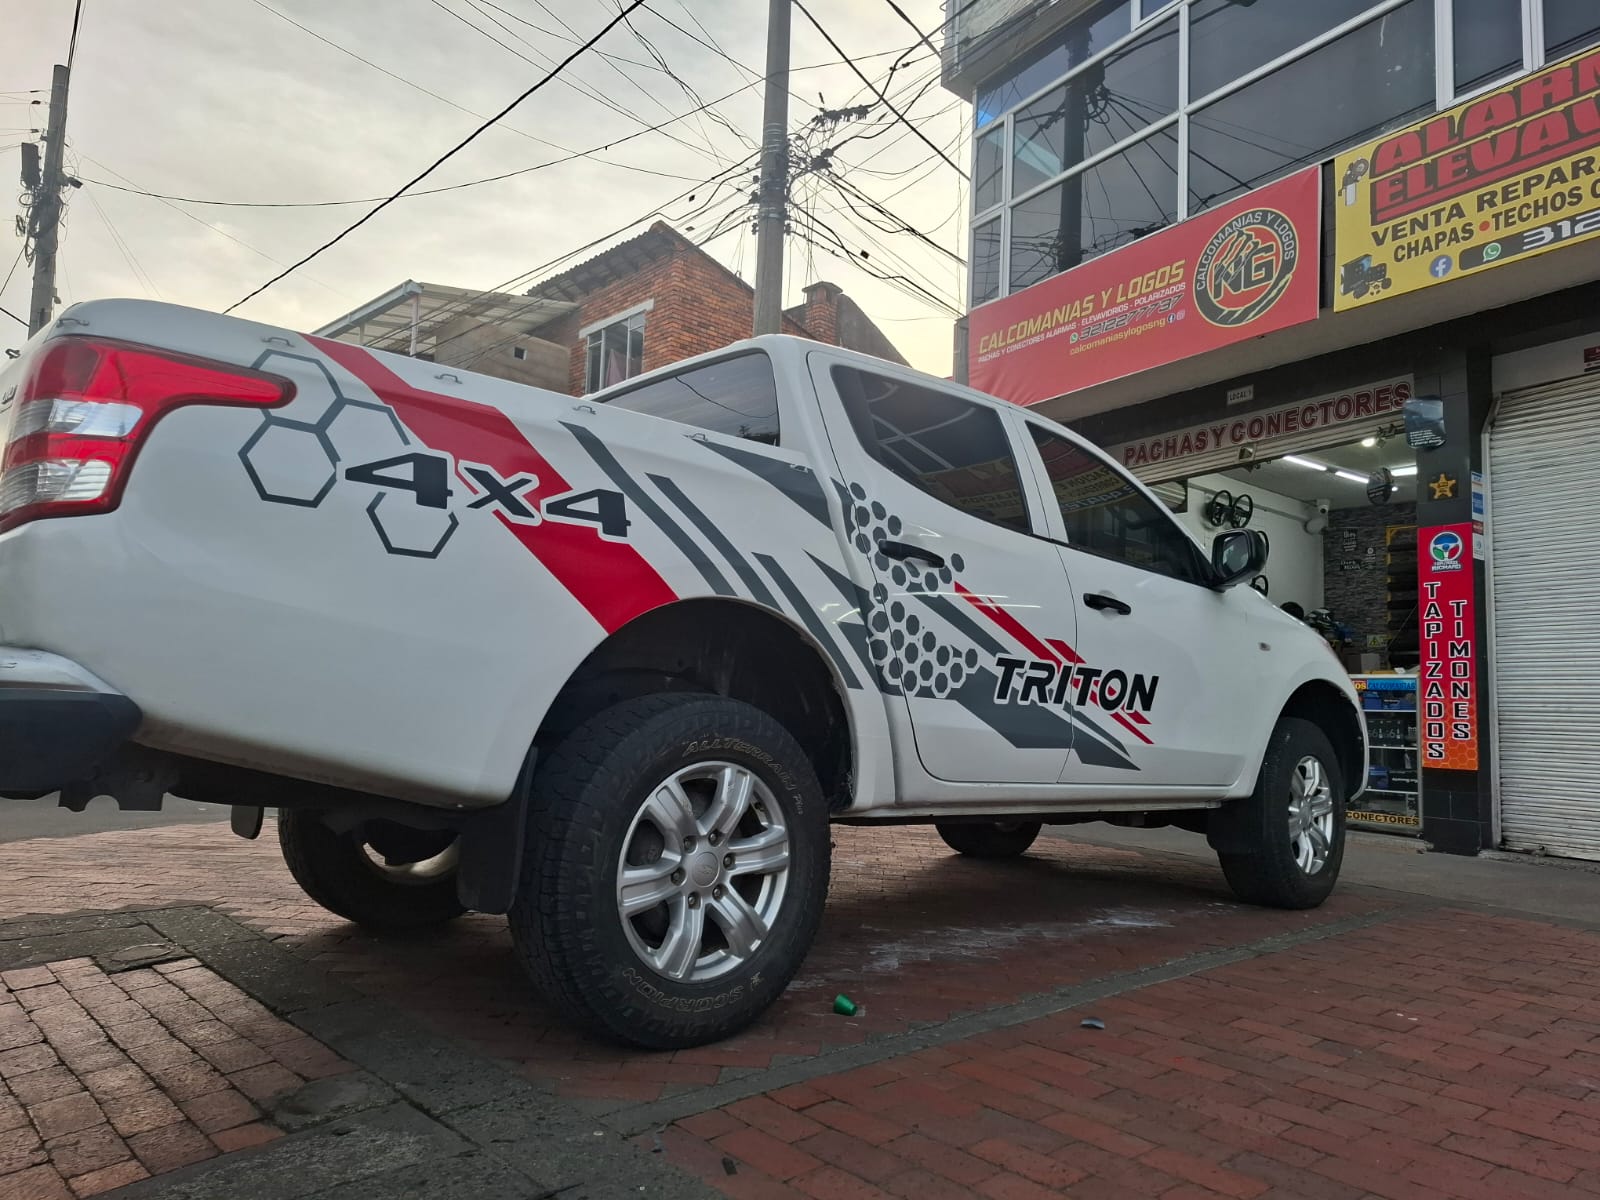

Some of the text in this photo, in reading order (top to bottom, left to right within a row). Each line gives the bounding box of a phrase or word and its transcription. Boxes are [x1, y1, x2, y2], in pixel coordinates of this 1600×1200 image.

[1371, 156, 1600, 246] VENTA REPAR
[1394, 222, 1474, 262] CHAPAS
[1492, 186, 1583, 231] TECHOS
[1197, 212, 1295, 290] CALCOMANIAS Y LOGOS
[979, 260, 1186, 354] CALCOMANIAS Y LOGOS
[1006, 334, 1045, 354] CONECTORES
[1046, 322, 1077, 339] ALARMAS
[1081, 303, 1128, 326] ELEVAVIDRIOS
[1134, 282, 1186, 307] POLARIZADOS
[1070, 317, 1166, 355] calcomaniasylogosng
[1123, 428, 1210, 467] PACHAS
[1210, 425, 1226, 449] Y
[1230, 381, 1411, 444] CONECTORES
[1229, 390, 1247, 401] LOCAL
[996, 657, 1159, 711] TRITON
[1424, 582, 1445, 759] TAPIZADOS
[1449, 600, 1471, 740] TIMONES
[1345, 811, 1420, 826] CONECTORES
[622, 967, 745, 1013] SCORPION
